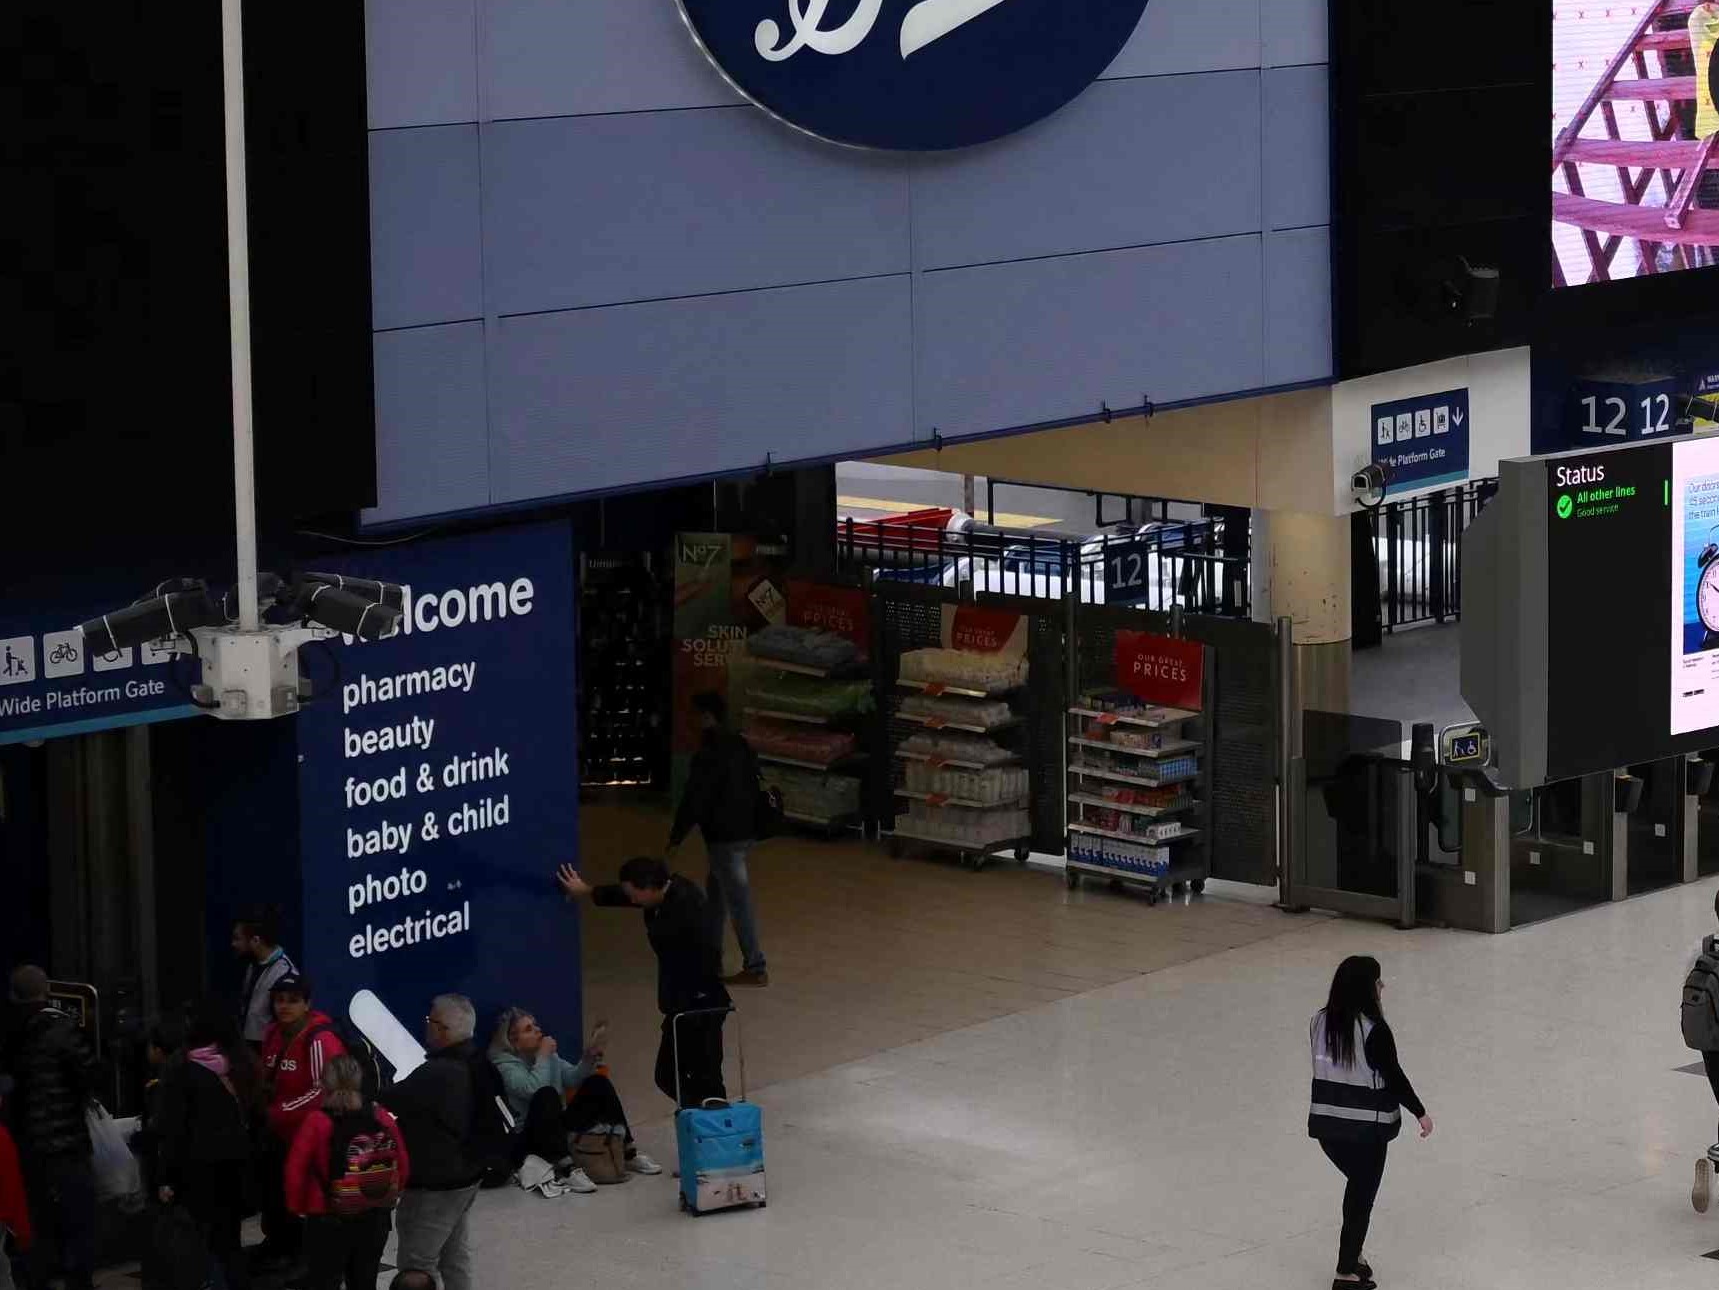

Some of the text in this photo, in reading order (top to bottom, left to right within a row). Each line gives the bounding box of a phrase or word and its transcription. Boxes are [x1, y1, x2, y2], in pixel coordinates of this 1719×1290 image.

[1581, 395, 1628, 436] 12
[1640, 392, 1671, 435] 12
[1397, 447, 1446, 466] Platform Gate
[1556, 463, 1605, 487] Status
[1577, 485, 1636, 504] All other lines
[1109, 552, 1143, 590] 12
[341, 658, 478, 714] pharmacy
[1133, 661, 1188, 682] PRICES
[45, 685, 121, 711] Platform
[124, 678, 166, 701] Gate
[342, 714, 436, 760] beauty
[344, 747, 510, 809] food & drink
[346, 794, 511, 861] baby & child
[347, 870, 428, 914] photo
[348, 903, 471, 960] electrical
